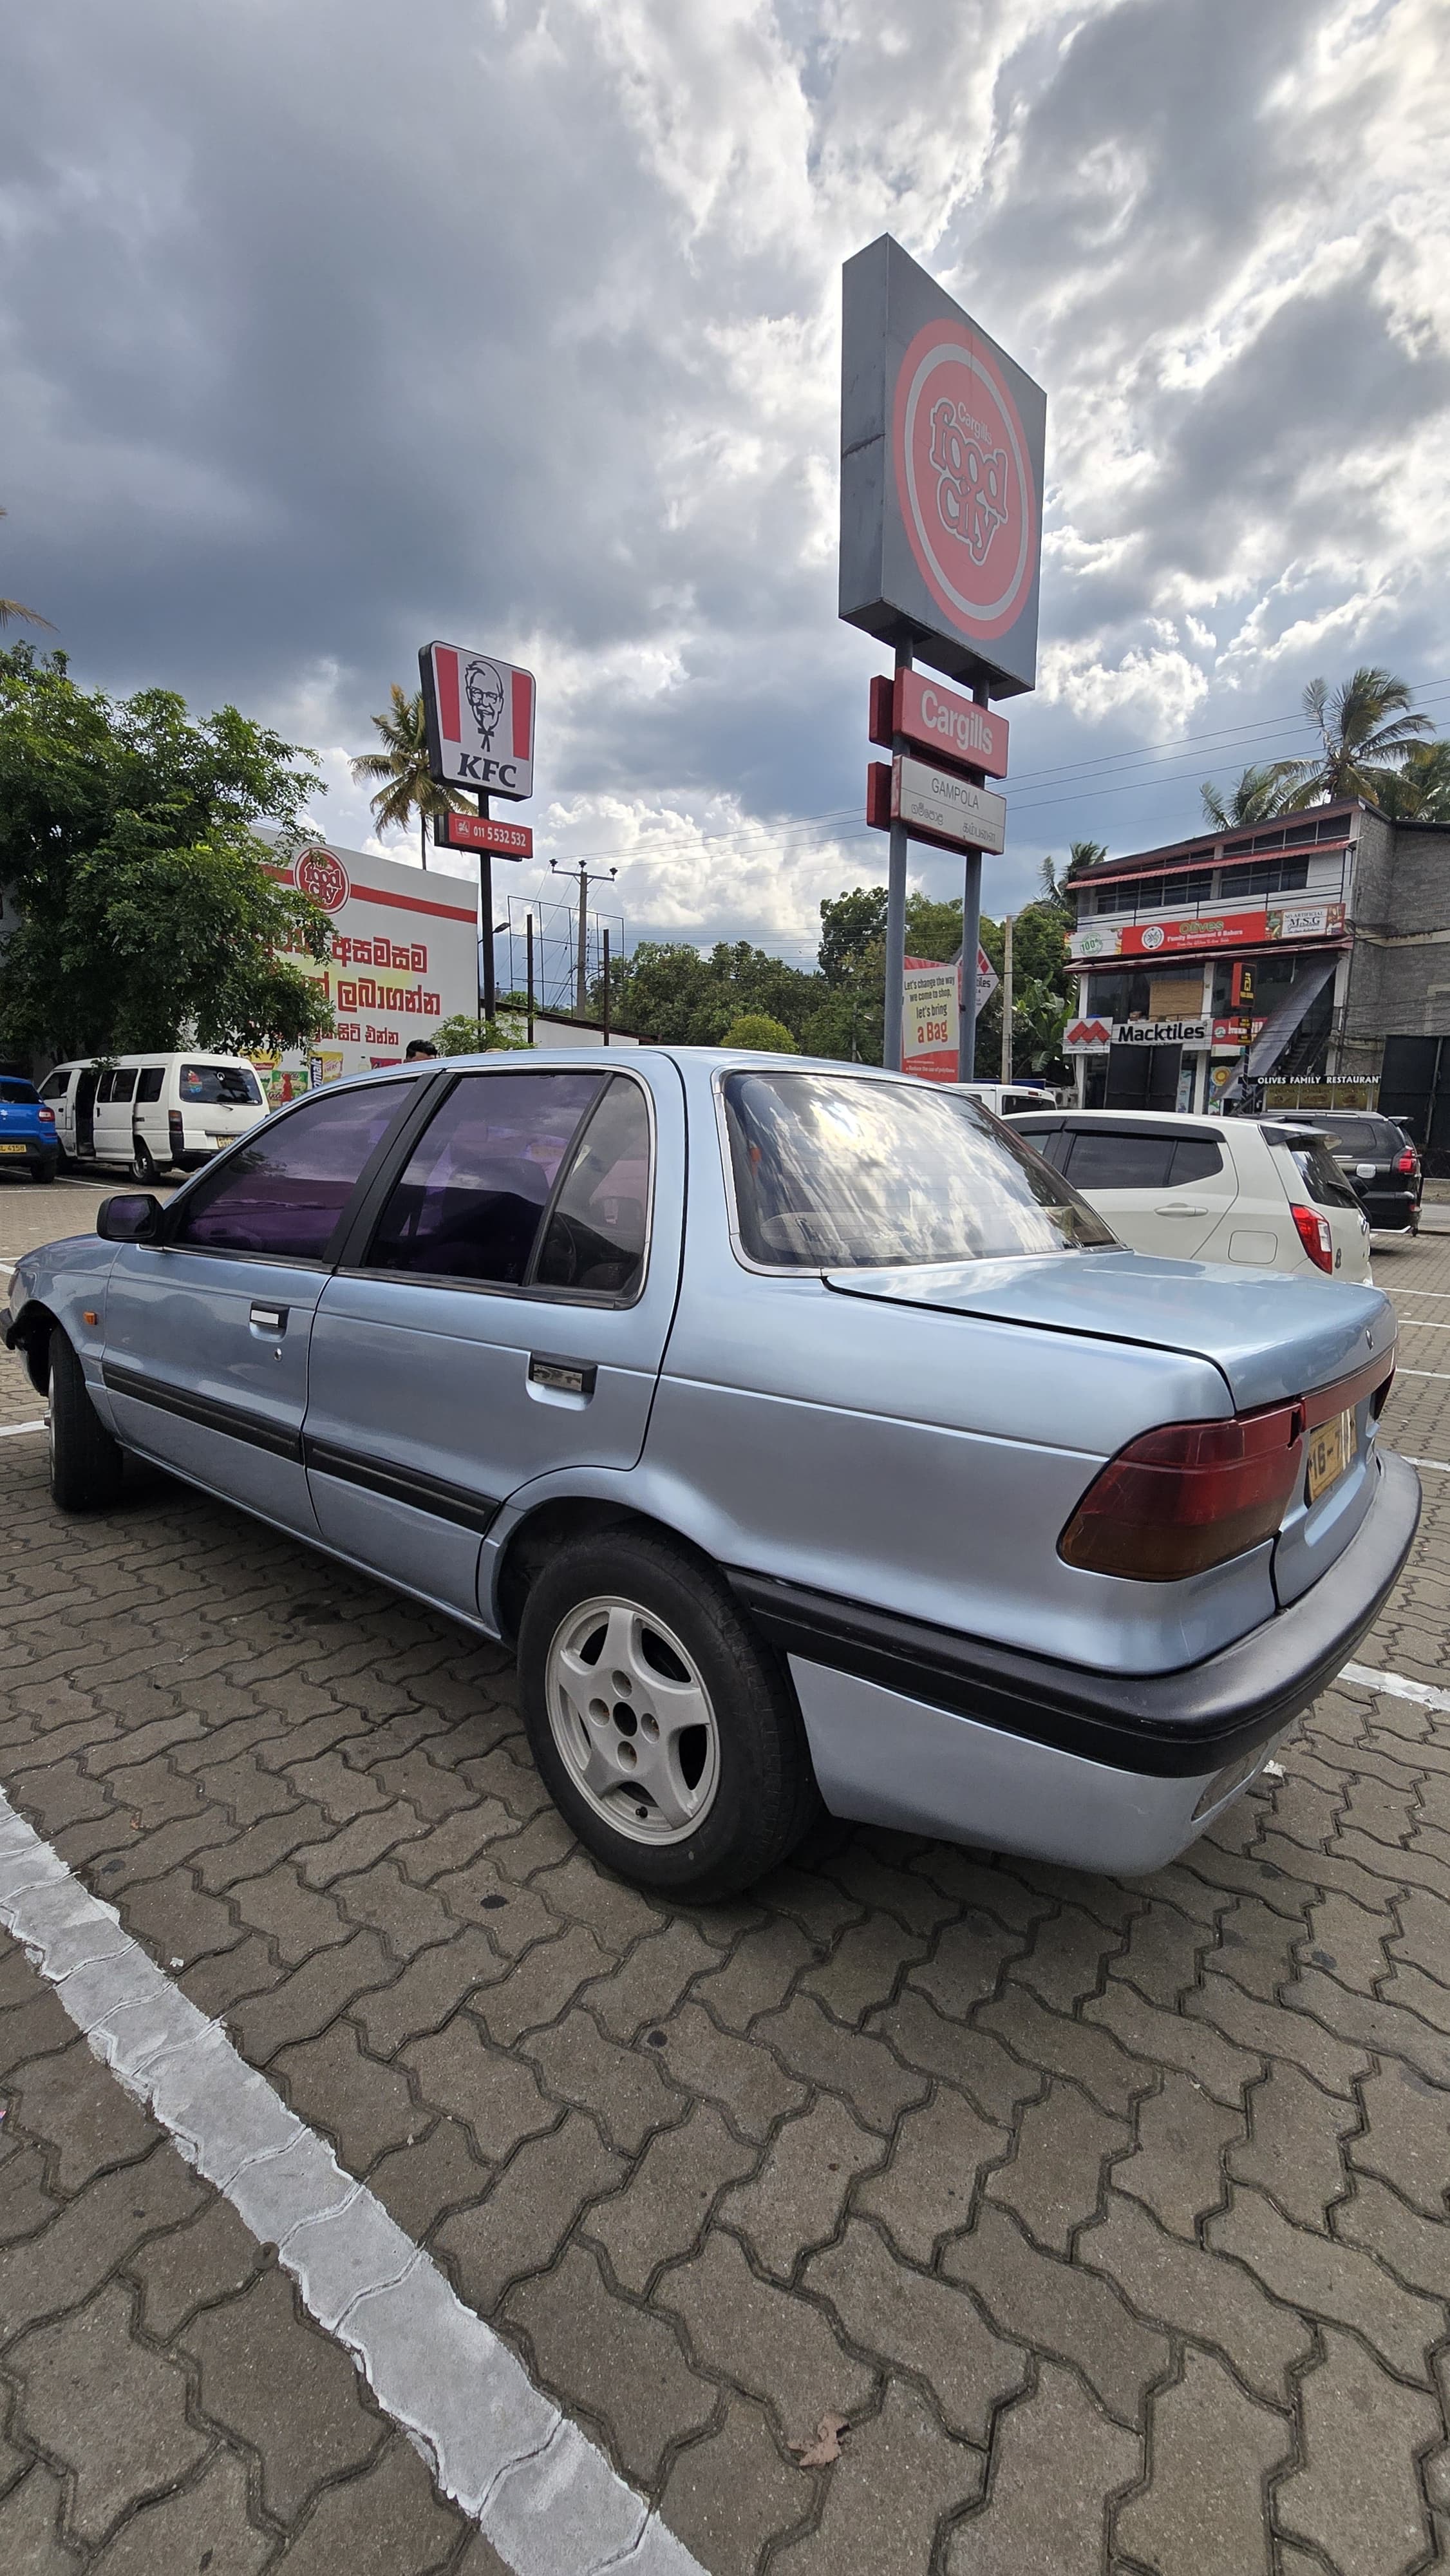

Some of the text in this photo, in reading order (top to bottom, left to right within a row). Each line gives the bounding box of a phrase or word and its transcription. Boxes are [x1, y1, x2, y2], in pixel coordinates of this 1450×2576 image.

[957, 402, 992, 445] Cargills
[921, 689, 993, 755] Cargills
[457, 752, 517, 788] KFC
[932, 777, 979, 810] GAMPOLA
[474, 826, 485, 837] 011
[511, 831, 526, 847] 532
[1179, 920, 1224, 934] Olives
[904, 976, 956, 990] Let's change the way
[337, 976, 440, 1016] ලබාගන්න
[909, 994, 918, 1002] we
[918, 990, 932, 1001] come
[932, 990, 938, 998] to
[916, 1003, 948, 1019] let's bring
[365, 1025, 399, 1045] එන්න
[918, 1019, 948, 1043] a Bag
[1118, 1023, 1205, 1042] Macktiles
[1290, 1076, 1321, 1084] FAMILY
